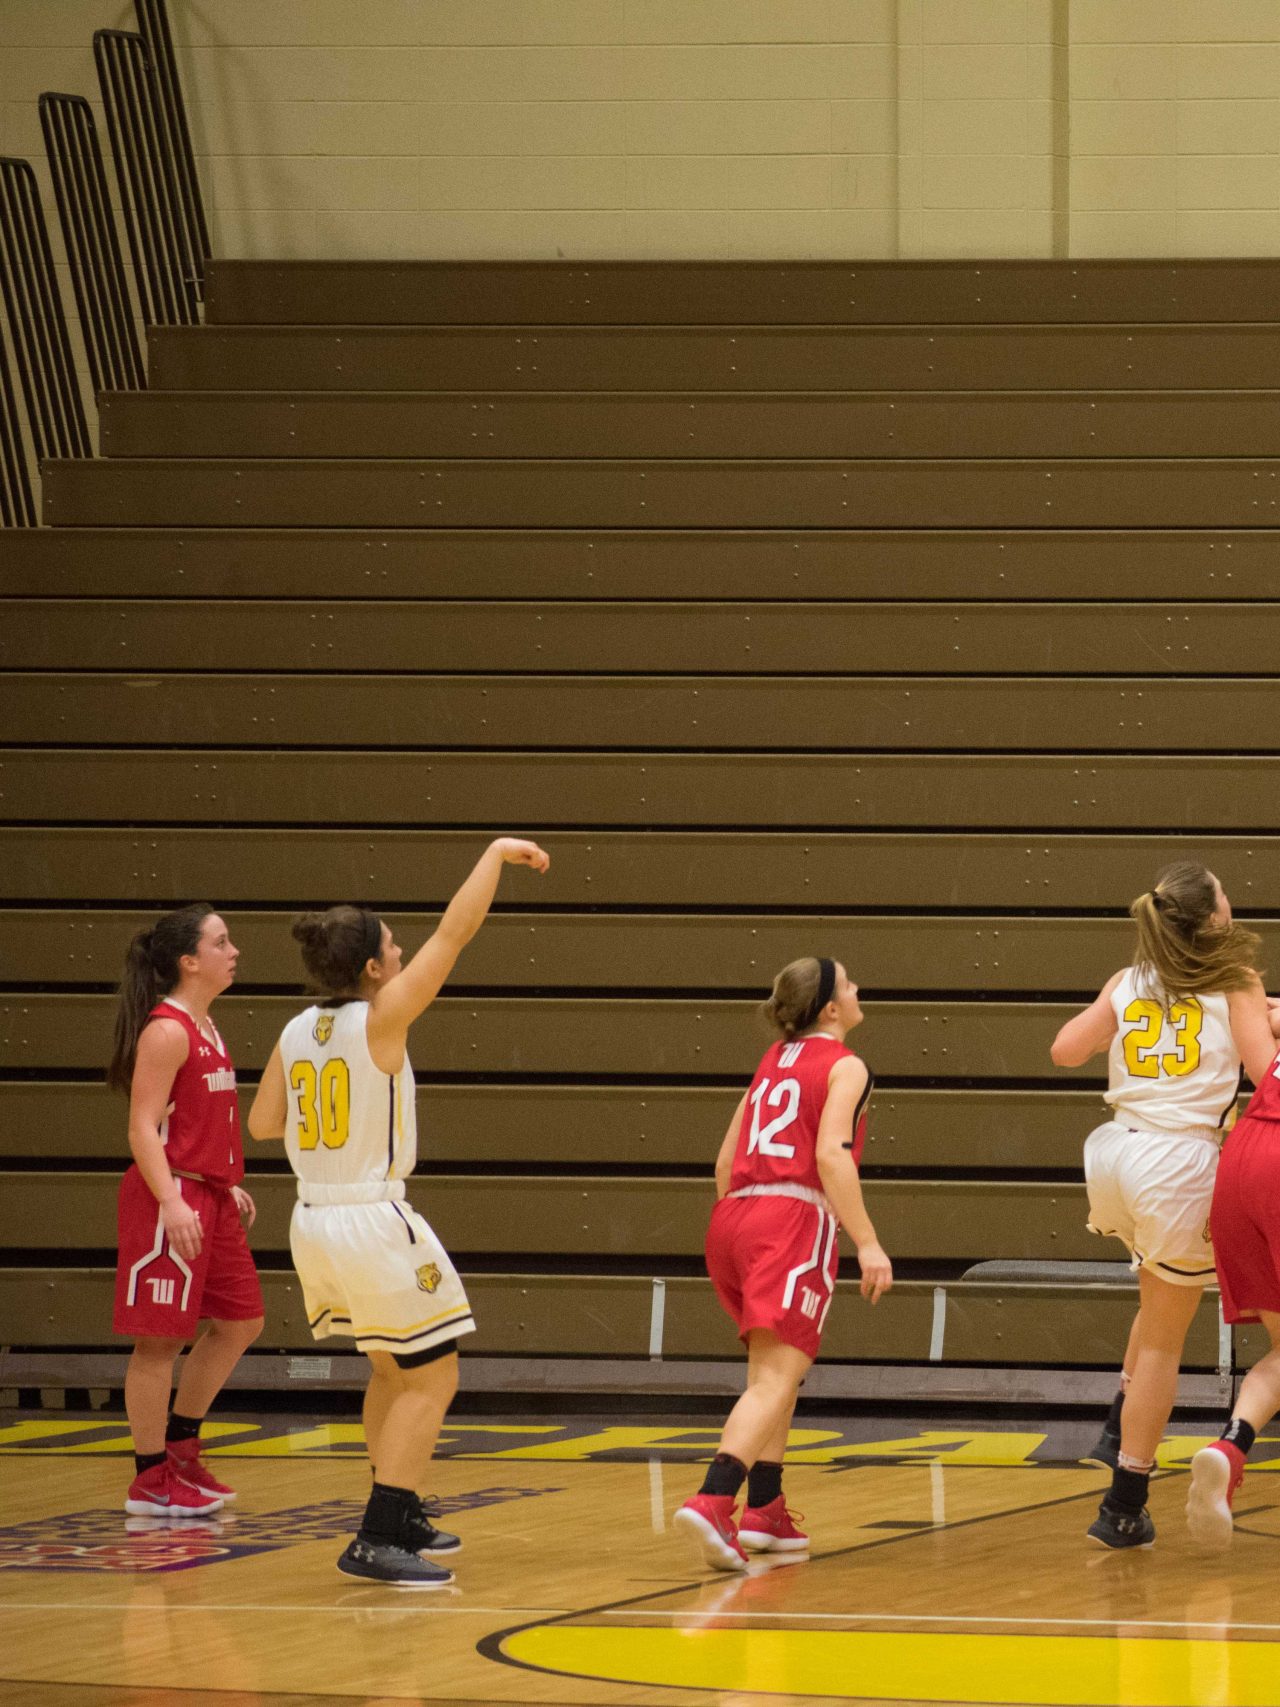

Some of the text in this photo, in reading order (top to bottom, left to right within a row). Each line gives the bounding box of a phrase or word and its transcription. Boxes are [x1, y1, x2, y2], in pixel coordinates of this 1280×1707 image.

[1122, 998, 1203, 1079] 23
[289, 1057, 350, 1150] 30
[747, 1078, 801, 1159] 12
